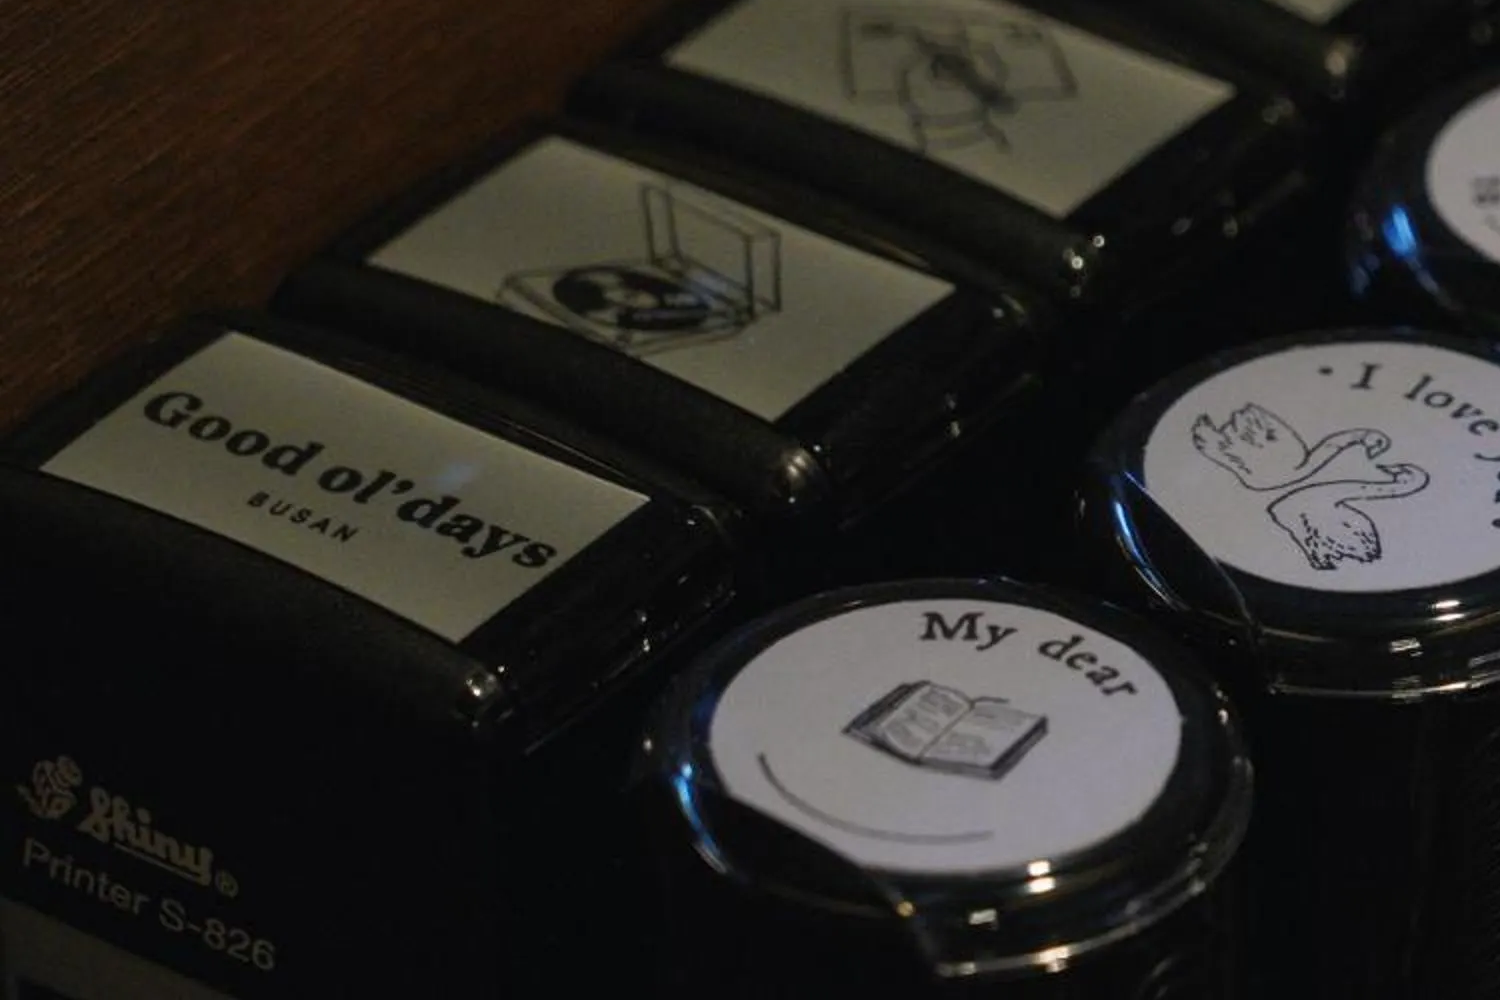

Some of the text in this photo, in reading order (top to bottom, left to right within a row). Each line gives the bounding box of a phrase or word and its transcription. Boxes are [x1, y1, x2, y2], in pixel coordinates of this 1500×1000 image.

[143, 391, 325, 476] Good
[1350, 363, 1382, 390] I
[1403, 374, 1500, 437] love
[247, 491, 360, 544] BUSAN
[920, 611, 1139, 697] My dear
[22, 836, 277, 971] Printer S-826
